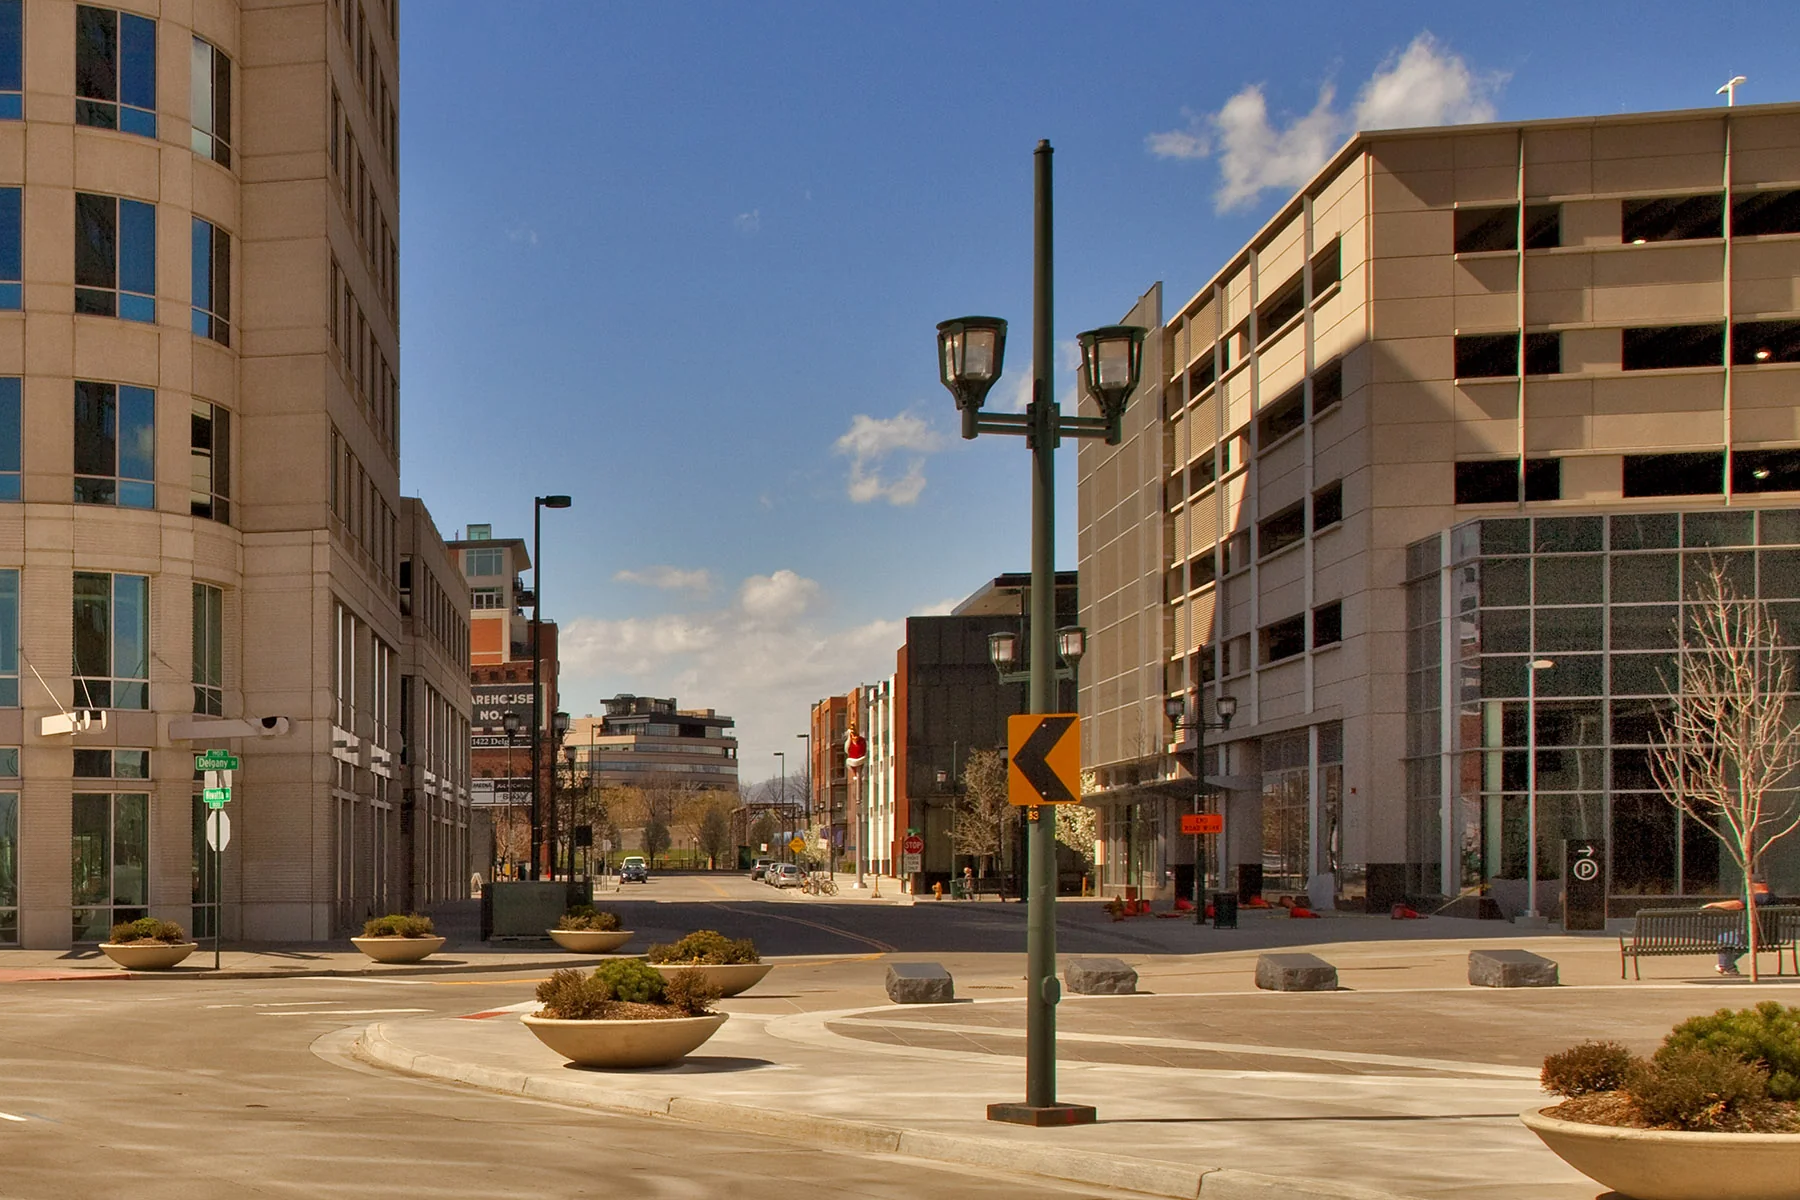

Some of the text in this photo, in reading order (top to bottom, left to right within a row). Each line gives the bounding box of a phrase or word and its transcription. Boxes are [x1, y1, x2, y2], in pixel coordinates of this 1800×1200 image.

[198, 758, 229, 769] Delgany
[905, 841, 921, 849] STOP
[1581, 863, 1592, 876] P
